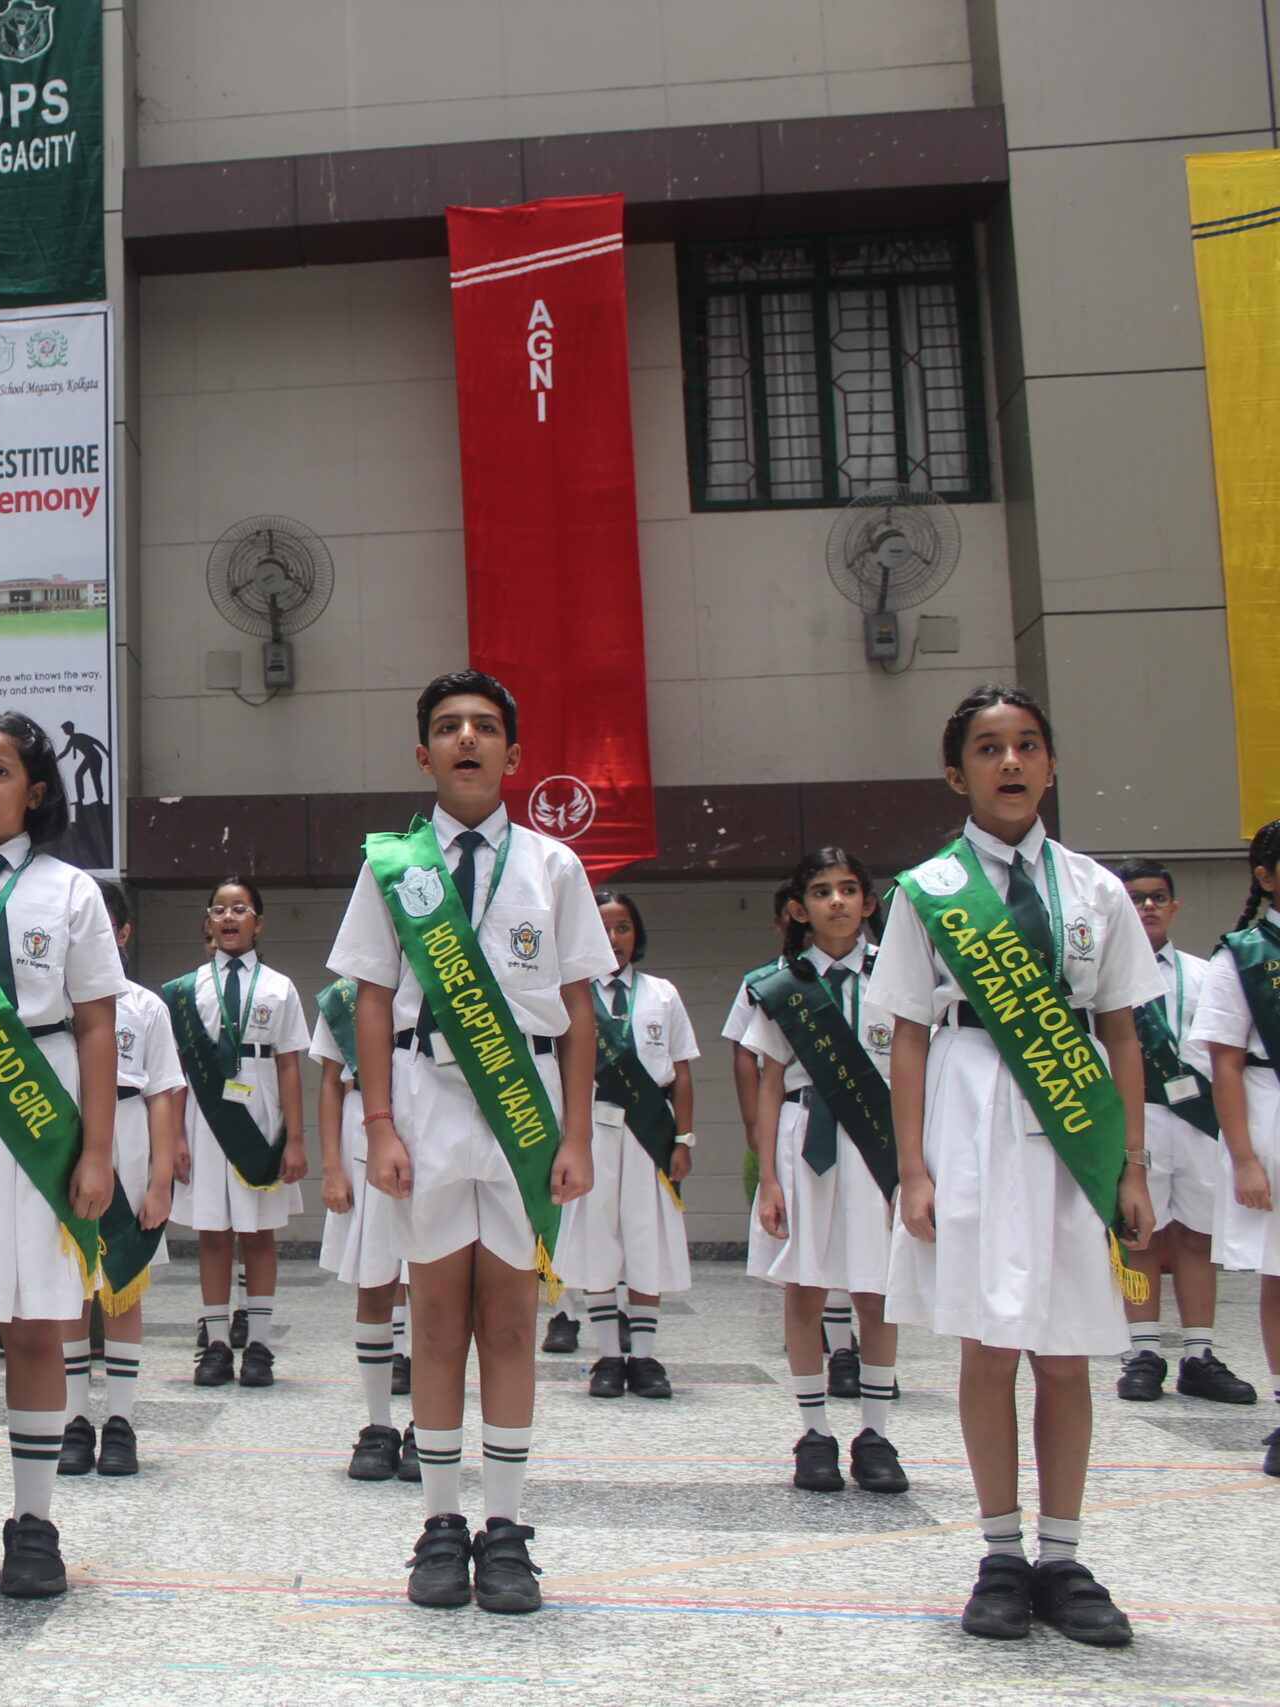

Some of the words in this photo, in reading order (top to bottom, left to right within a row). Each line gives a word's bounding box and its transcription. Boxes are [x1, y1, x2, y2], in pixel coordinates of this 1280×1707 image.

[66, 376, 99, 392] Kolkata
[527, 299, 554, 422] AGNI
[10, 685, 27, 695] and
[30, 684, 55, 694] shows
[58, 683, 72, 693] the
[14, 673, 32, 682] who
[34, 671, 61, 681] knows
[64, 670, 78, 679] the
[422, 920, 476, 994] HOUSE
[451, 988, 516, 1077] CAPTAIN
[498, 1078, 548, 1149] VAAYU
[941, 908, 1025, 1024] CAPTAIN
[1022, 1037, 1093, 1134] VAAYU
[986, 919, 1043, 988] VICE
[1025, 985, 1102, 1089] HOUSE
[8, 1080, 58, 1140] GIRL
